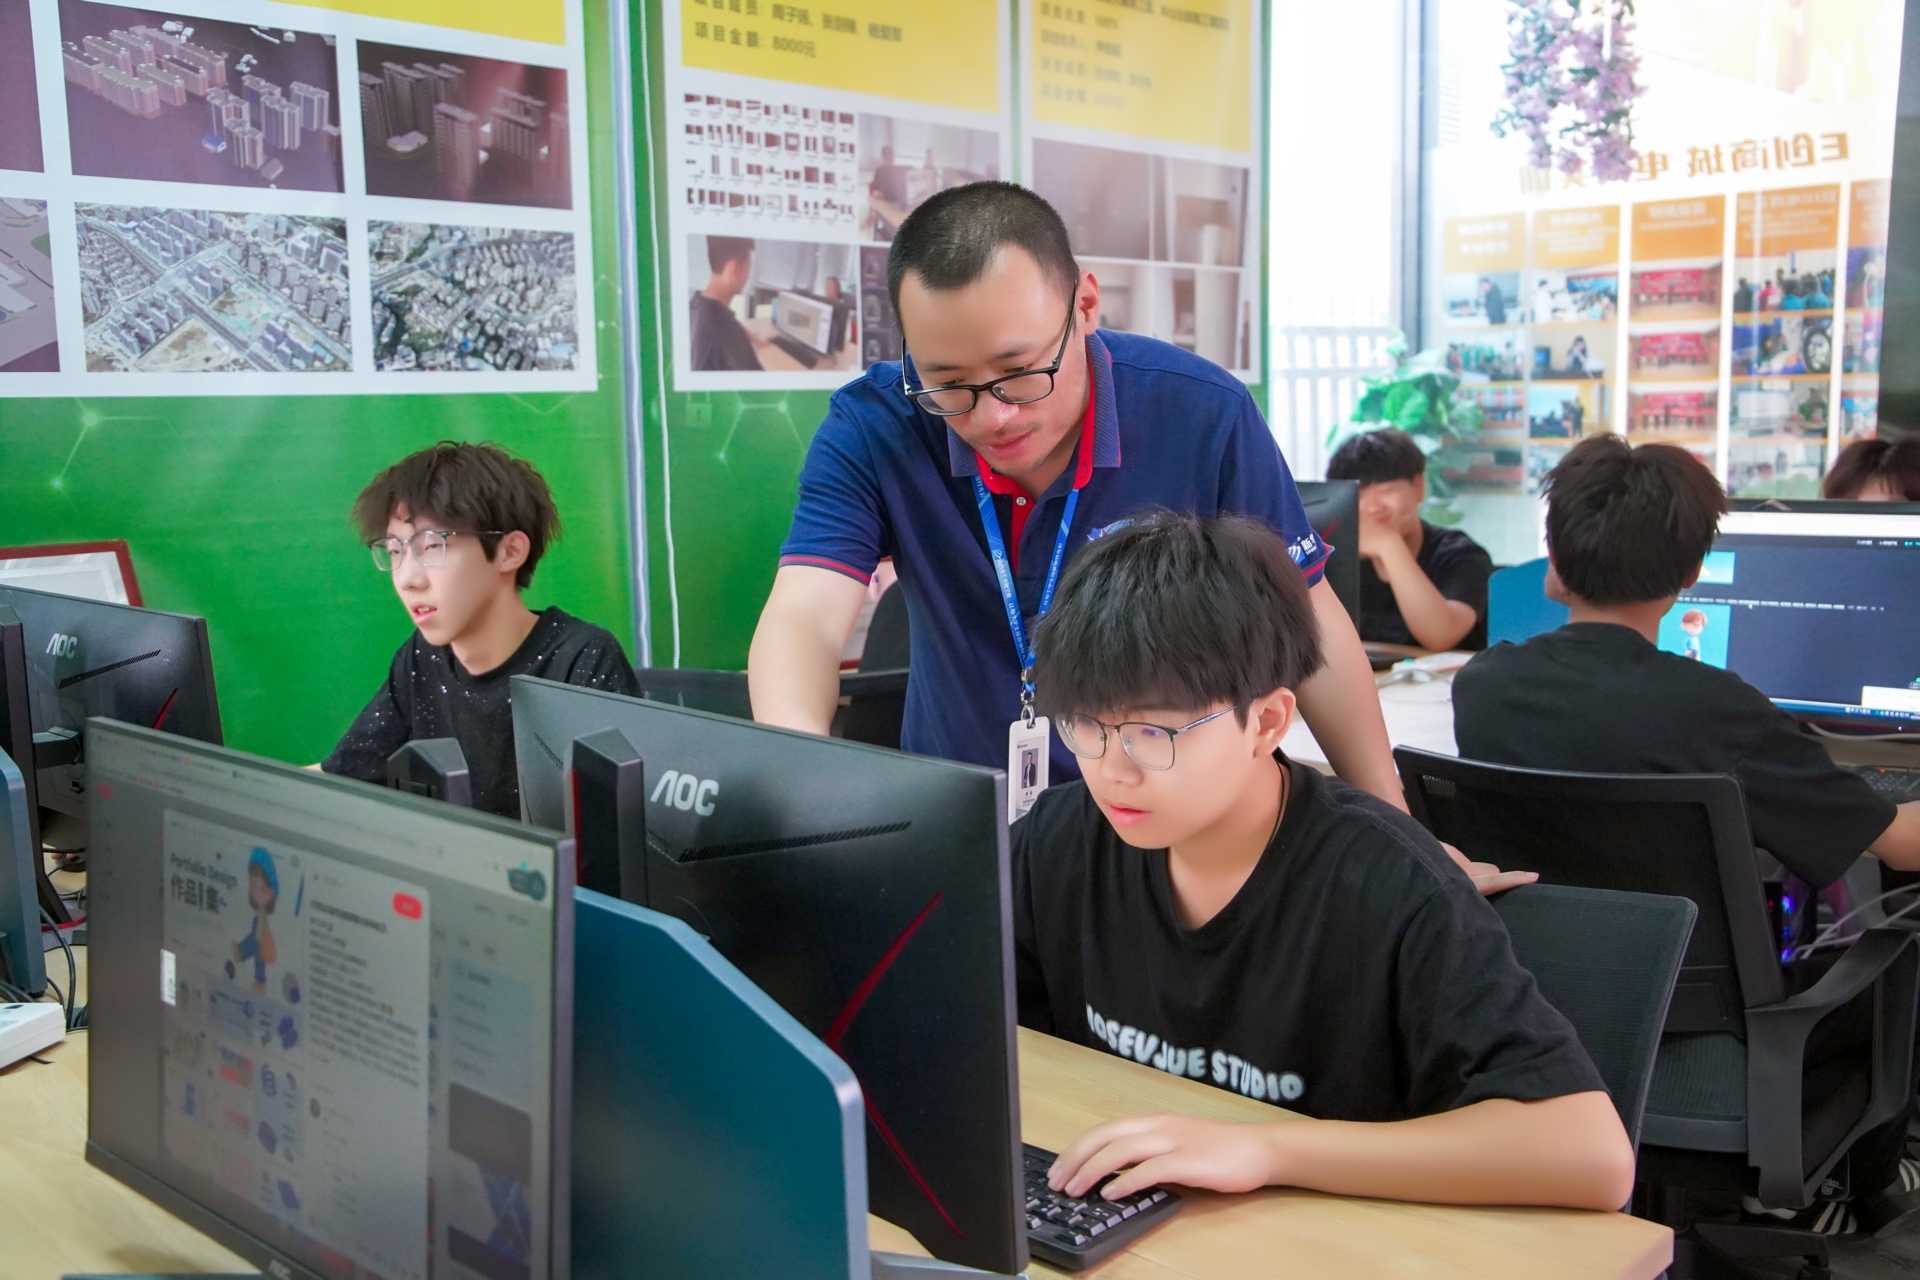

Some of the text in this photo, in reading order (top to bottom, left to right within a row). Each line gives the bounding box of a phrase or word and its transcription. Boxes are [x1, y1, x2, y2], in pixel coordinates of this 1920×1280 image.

[45, 633, 78, 659] AOC
[651, 770, 720, 816] AOC
[1211, 1049, 1305, 1101] STUDIO
